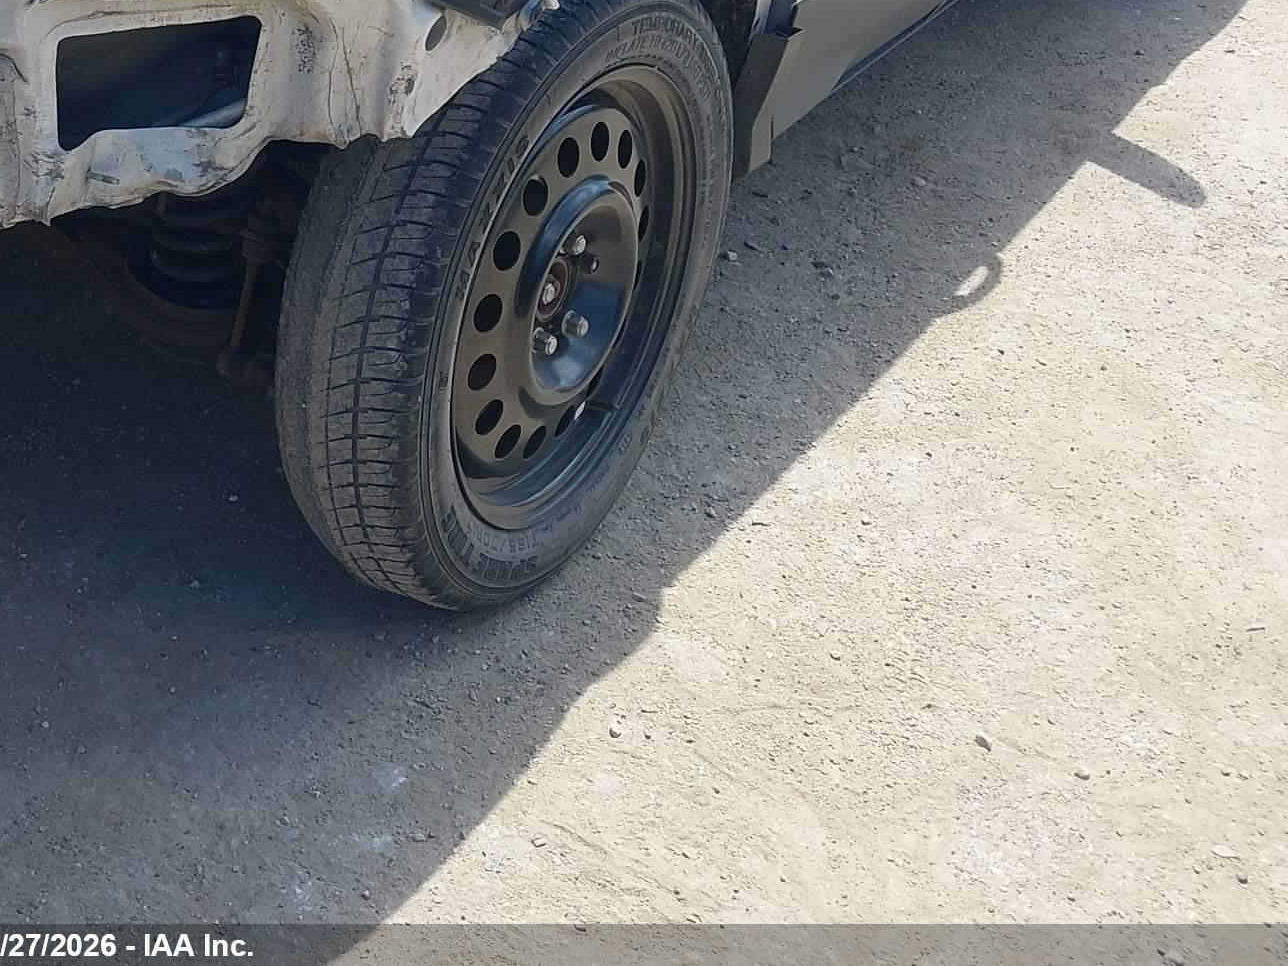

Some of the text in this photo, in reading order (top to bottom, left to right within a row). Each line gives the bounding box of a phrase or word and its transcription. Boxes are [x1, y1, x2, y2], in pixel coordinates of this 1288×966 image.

[631, 15, 701, 51] TEMPORARY
[455, 134, 530, 301] MAXXIS
[473, 552, 538, 582] SPARE
